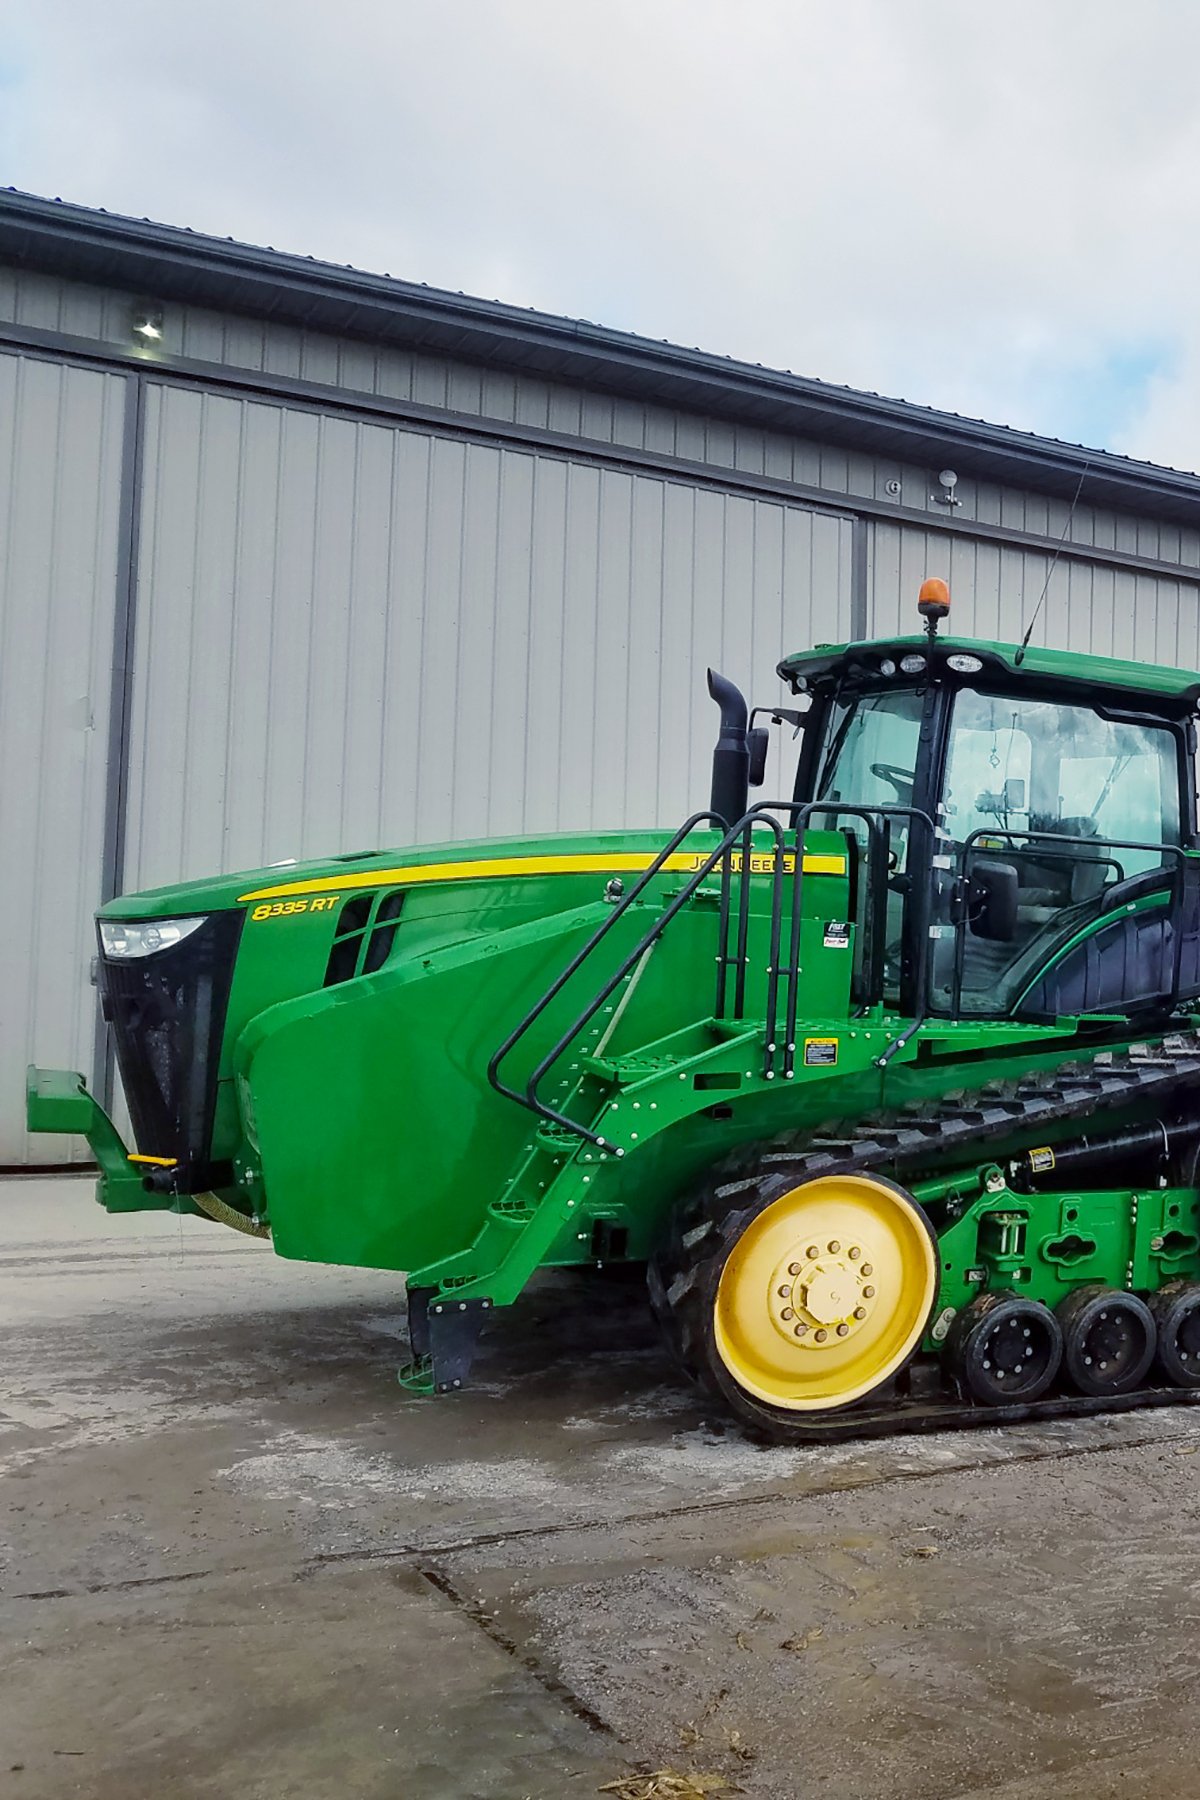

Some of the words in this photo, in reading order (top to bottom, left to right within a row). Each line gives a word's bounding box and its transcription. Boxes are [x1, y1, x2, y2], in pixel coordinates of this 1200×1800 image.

[738, 857, 792, 871] DEEE
[251, 899, 309, 921] 8335
[309, 896, 340, 912] RT
